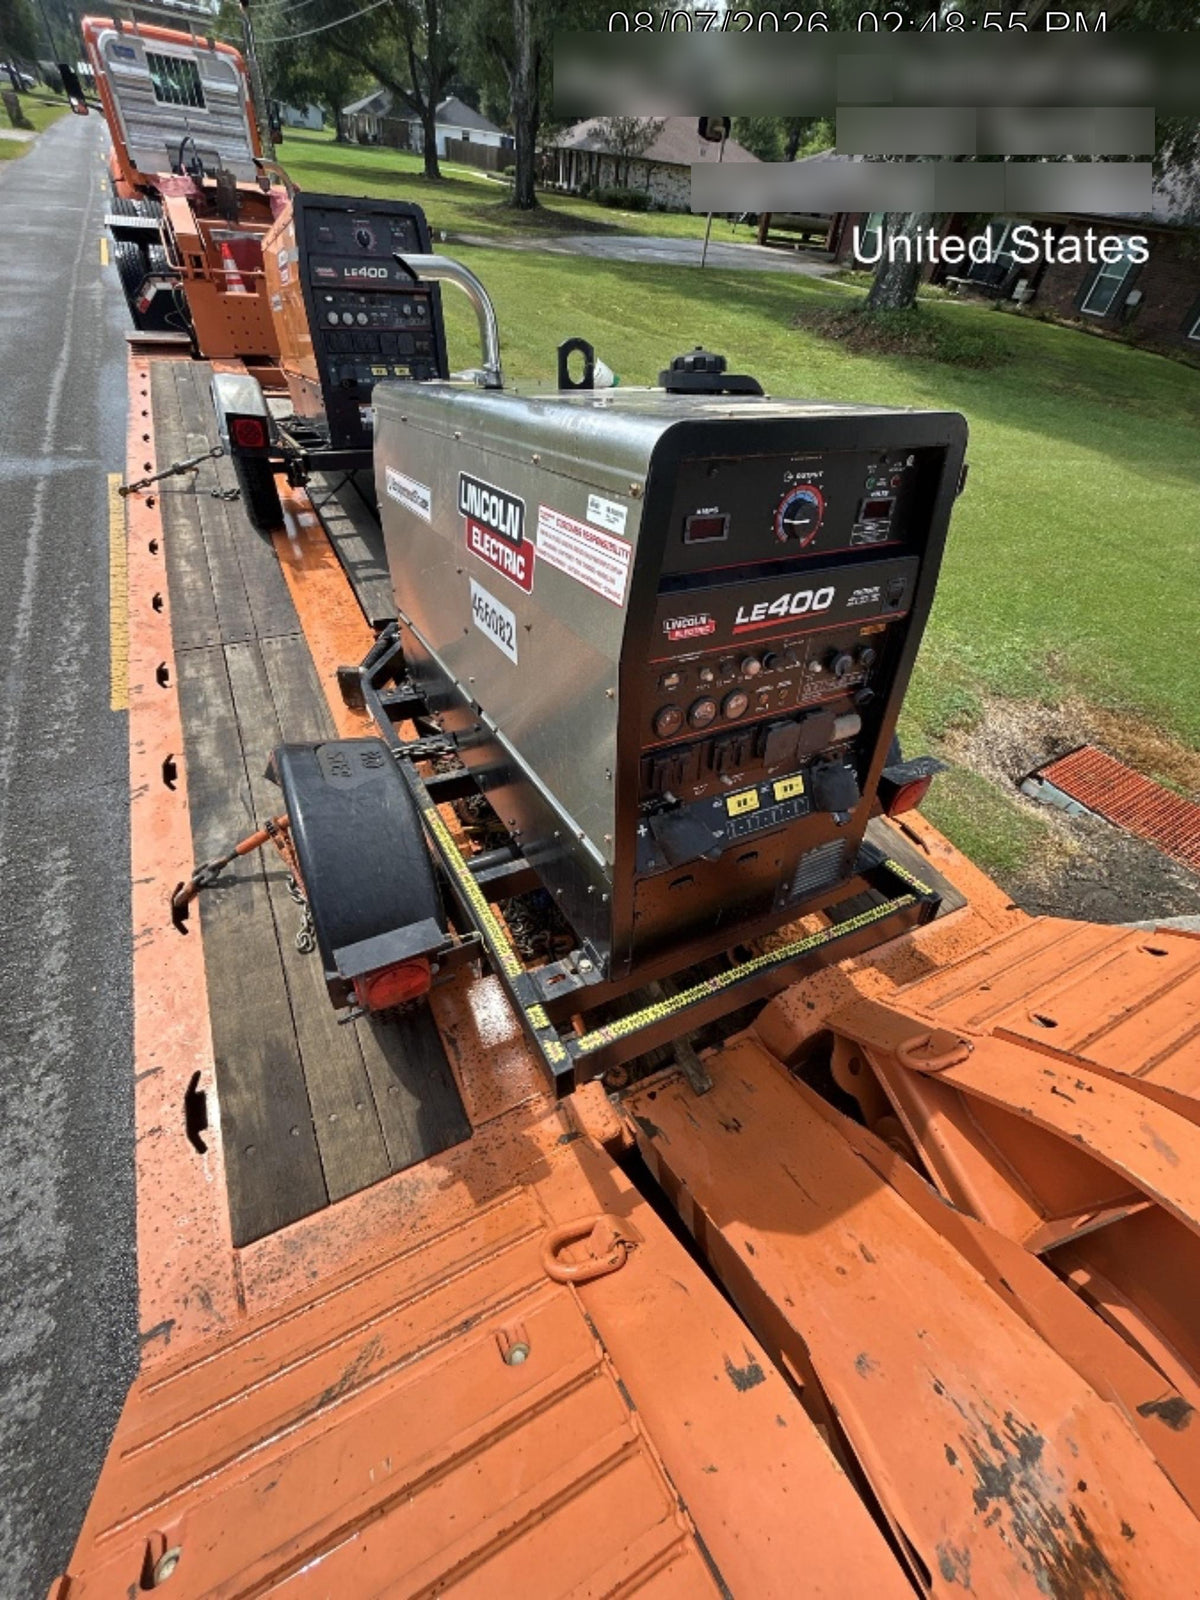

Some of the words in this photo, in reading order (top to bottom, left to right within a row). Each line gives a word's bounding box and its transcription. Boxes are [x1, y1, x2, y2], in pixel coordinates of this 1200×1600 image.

[344, 267, 388, 278] LE400
[460, 479, 520, 540] LINCOLN
[472, 525, 525, 581] ELECTRIC
[665, 615, 707, 630] LINCOLN
[735, 586, 835, 625] LE400
